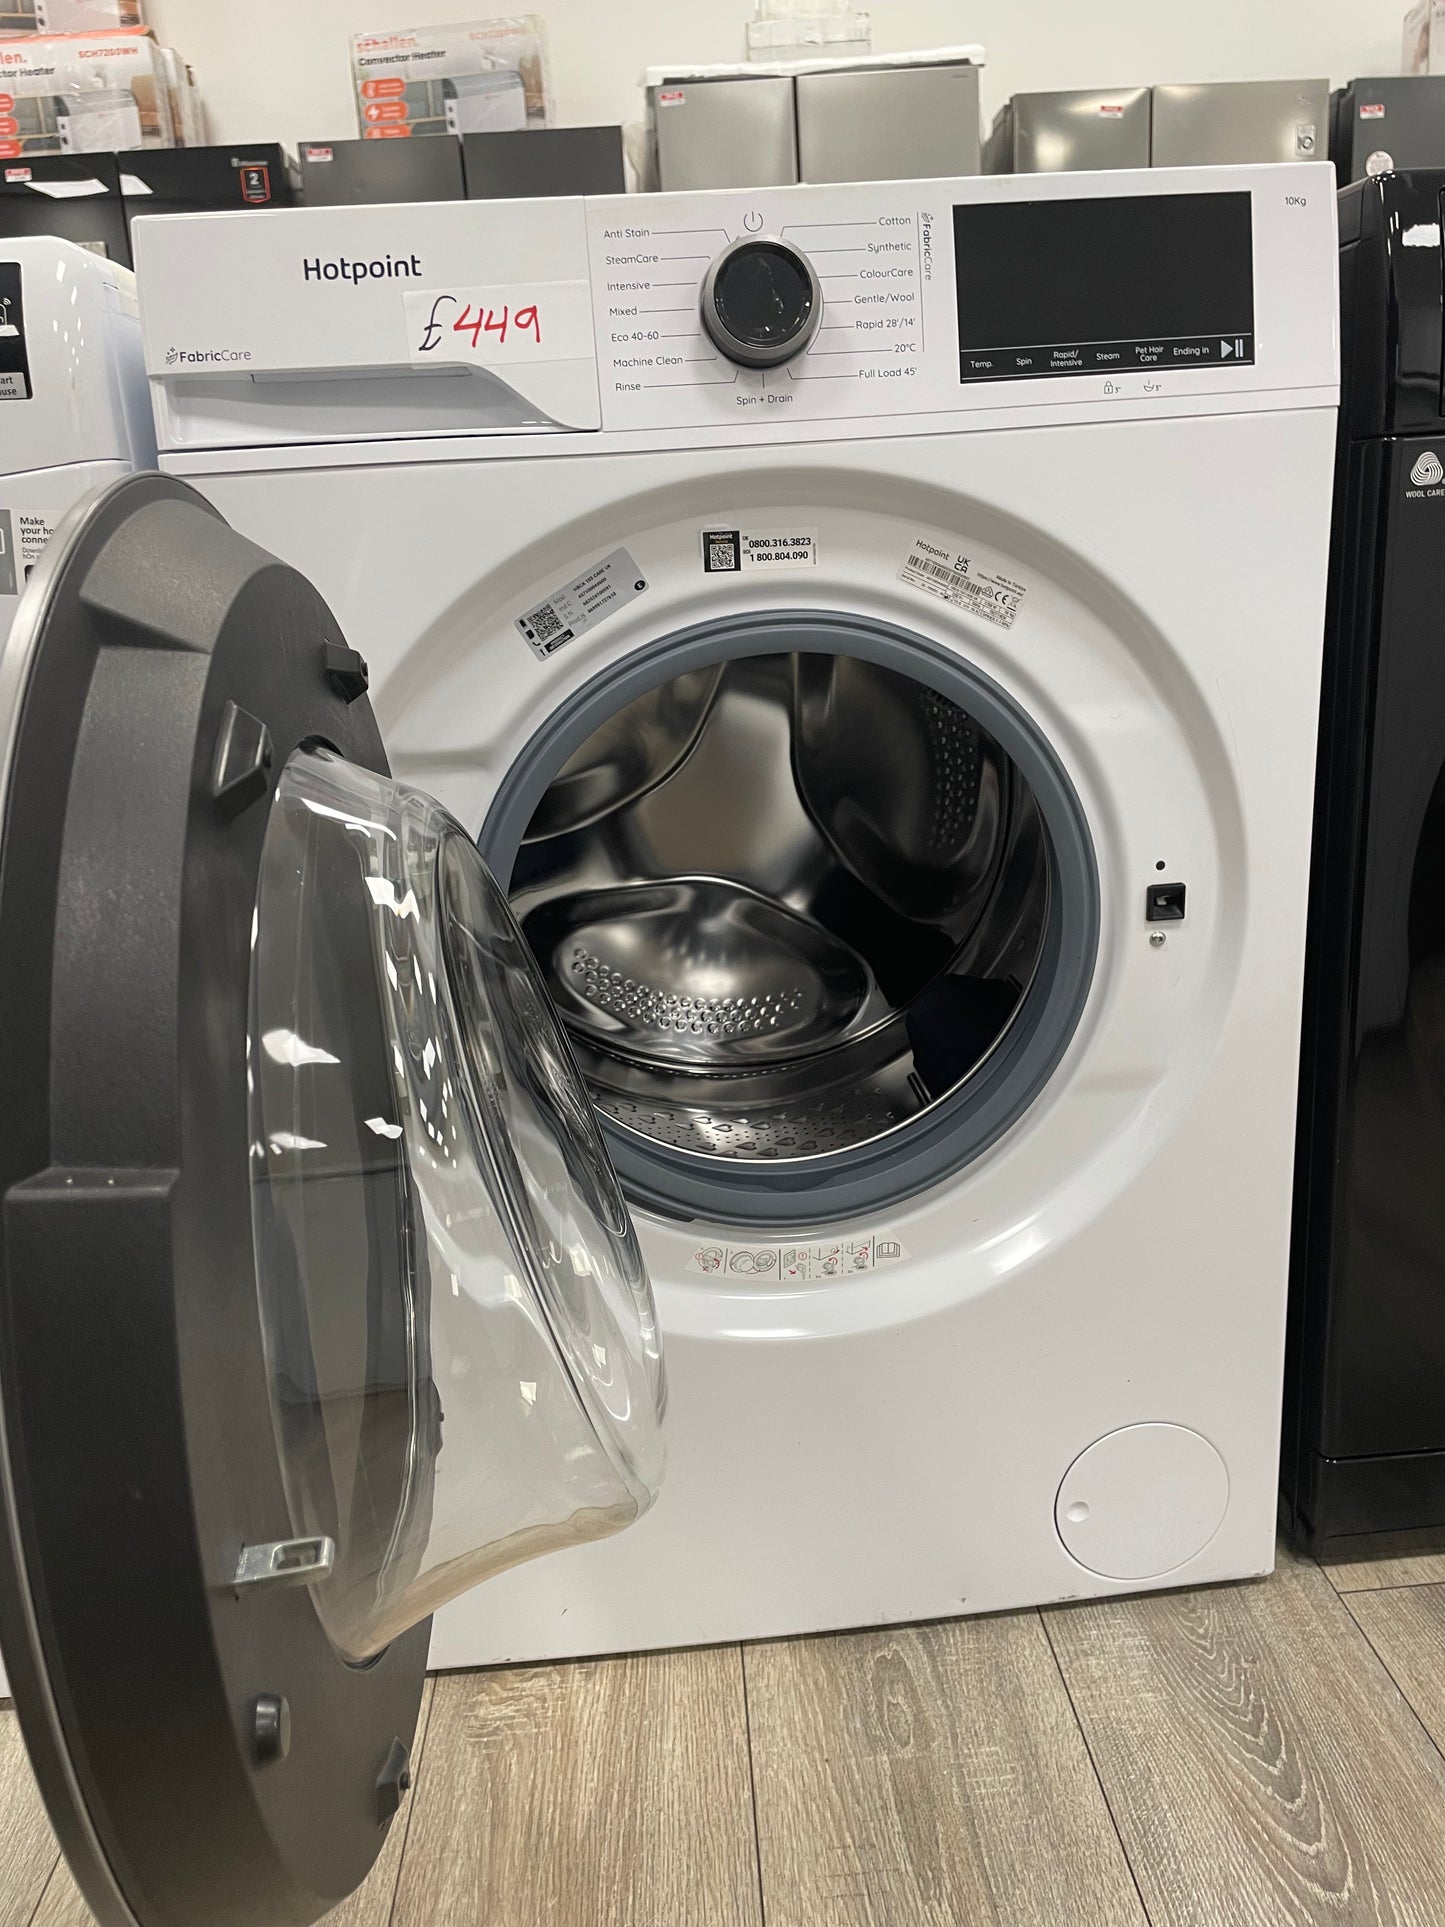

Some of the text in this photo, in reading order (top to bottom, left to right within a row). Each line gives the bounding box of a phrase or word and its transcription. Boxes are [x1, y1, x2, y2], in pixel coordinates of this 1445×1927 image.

[249, 172, 260, 185] 2
[1285, 196, 1307, 207] 10Kg
[878, 216, 912, 227] Cotton
[603, 228, 650, 239] Anti Stain
[867, 242, 912, 255] Synthetic
[922, 223, 933, 282] FabricCare
[605, 255, 660, 266] SteamCare
[303, 254, 423, 285] Hotpoint
[859, 269, 914, 281] ColourCare
[607, 281, 651, 292] Intensive
[854, 292, 915, 305] Gentle/Wool
[609, 307, 638, 317] Mixed
[418, 295, 542, 352] £449
[856, 319, 884, 332] Rapid
[611, 331, 660, 343] Eco 40-60
[894, 343, 917, 354] 20°C
[1135, 345, 1164, 355] Pet Hair
[1173, 346, 1210, 356] Ending in
[179, 349, 252, 363] FabricCare
[1053, 349, 1079, 360] Rapid/
[1096, 352, 1120, 361] Steam
[1140, 354, 1158, 362] Care
[613, 356, 684, 369] Machine Clean
[970, 360, 993, 369] Temp.
[1016, 357, 1033, 367] Spin
[1050, 358, 1083, 368] Intensive
[859, 370, 876, 380] Full
[878, 368, 902, 379] Load
[615, 382, 642, 393] Rinse
[736, 396, 756, 406] Spin
[767, 394, 793, 404] Drain
[1405, 489, 1445, 498] WOOL CARE
[20, 517, 45, 526] Make
[20, 528, 41, 536] your
[748, 537, 811, 549] 0800.316.3823
[916, 540, 950, 561] Hotpoint
[756, 551, 809, 562] 800.804.090
[957, 555, 971, 566] UK
